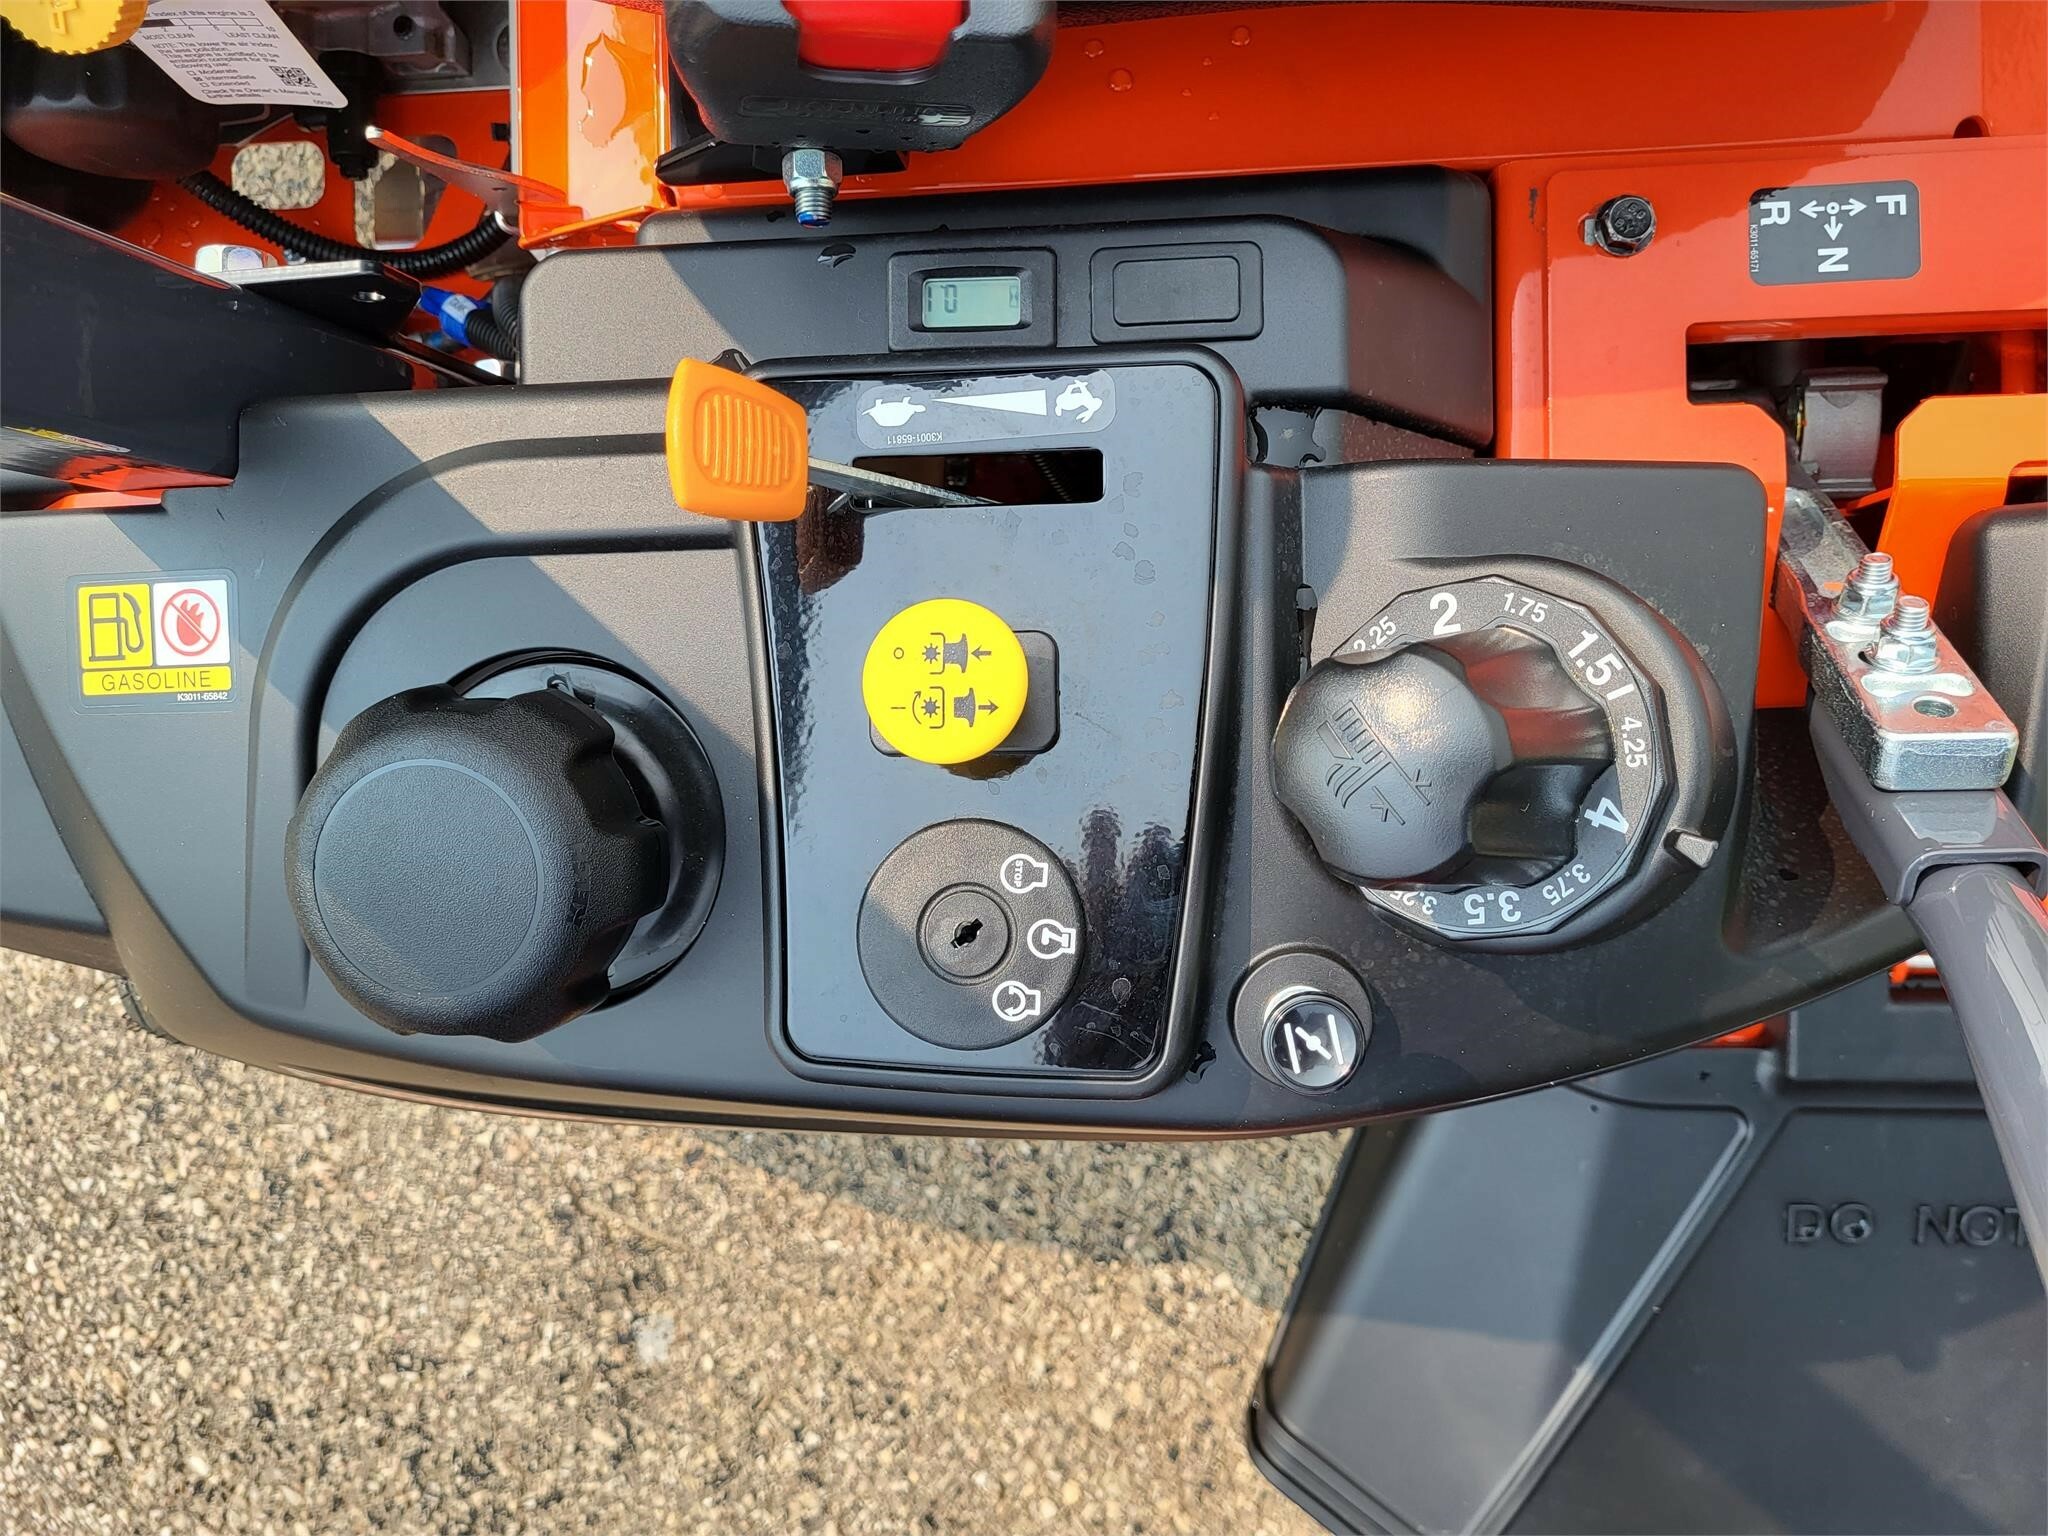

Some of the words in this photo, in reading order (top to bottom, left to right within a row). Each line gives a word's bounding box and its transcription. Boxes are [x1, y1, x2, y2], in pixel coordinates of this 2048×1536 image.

[1759, 201, 1791, 226] R
[1875, 194, 1906, 215] F
[1750, 224, 1760, 273] K3011-65171
[1817, 247, 1849, 273] N
[887, 431, 943, 445] K3001-65811
[1429, 592, 1461, 636] 2
[1503, 592, 1548, 623] 1.75
[1567, 629, 1624, 686] 1.5
[101, 670, 212, 691] GASOLINE
[177, 692, 228, 702] K3011-65842
[1621, 716, 1648, 769] 4.25
[1583, 796, 1630, 834] 4
[1014, 859, 1024, 888] STOP
[1542, 863, 1591, 906] 3.75
[1463, 890, 1521, 925] 3.5
[1785, 1201, 1873, 1245] DO
